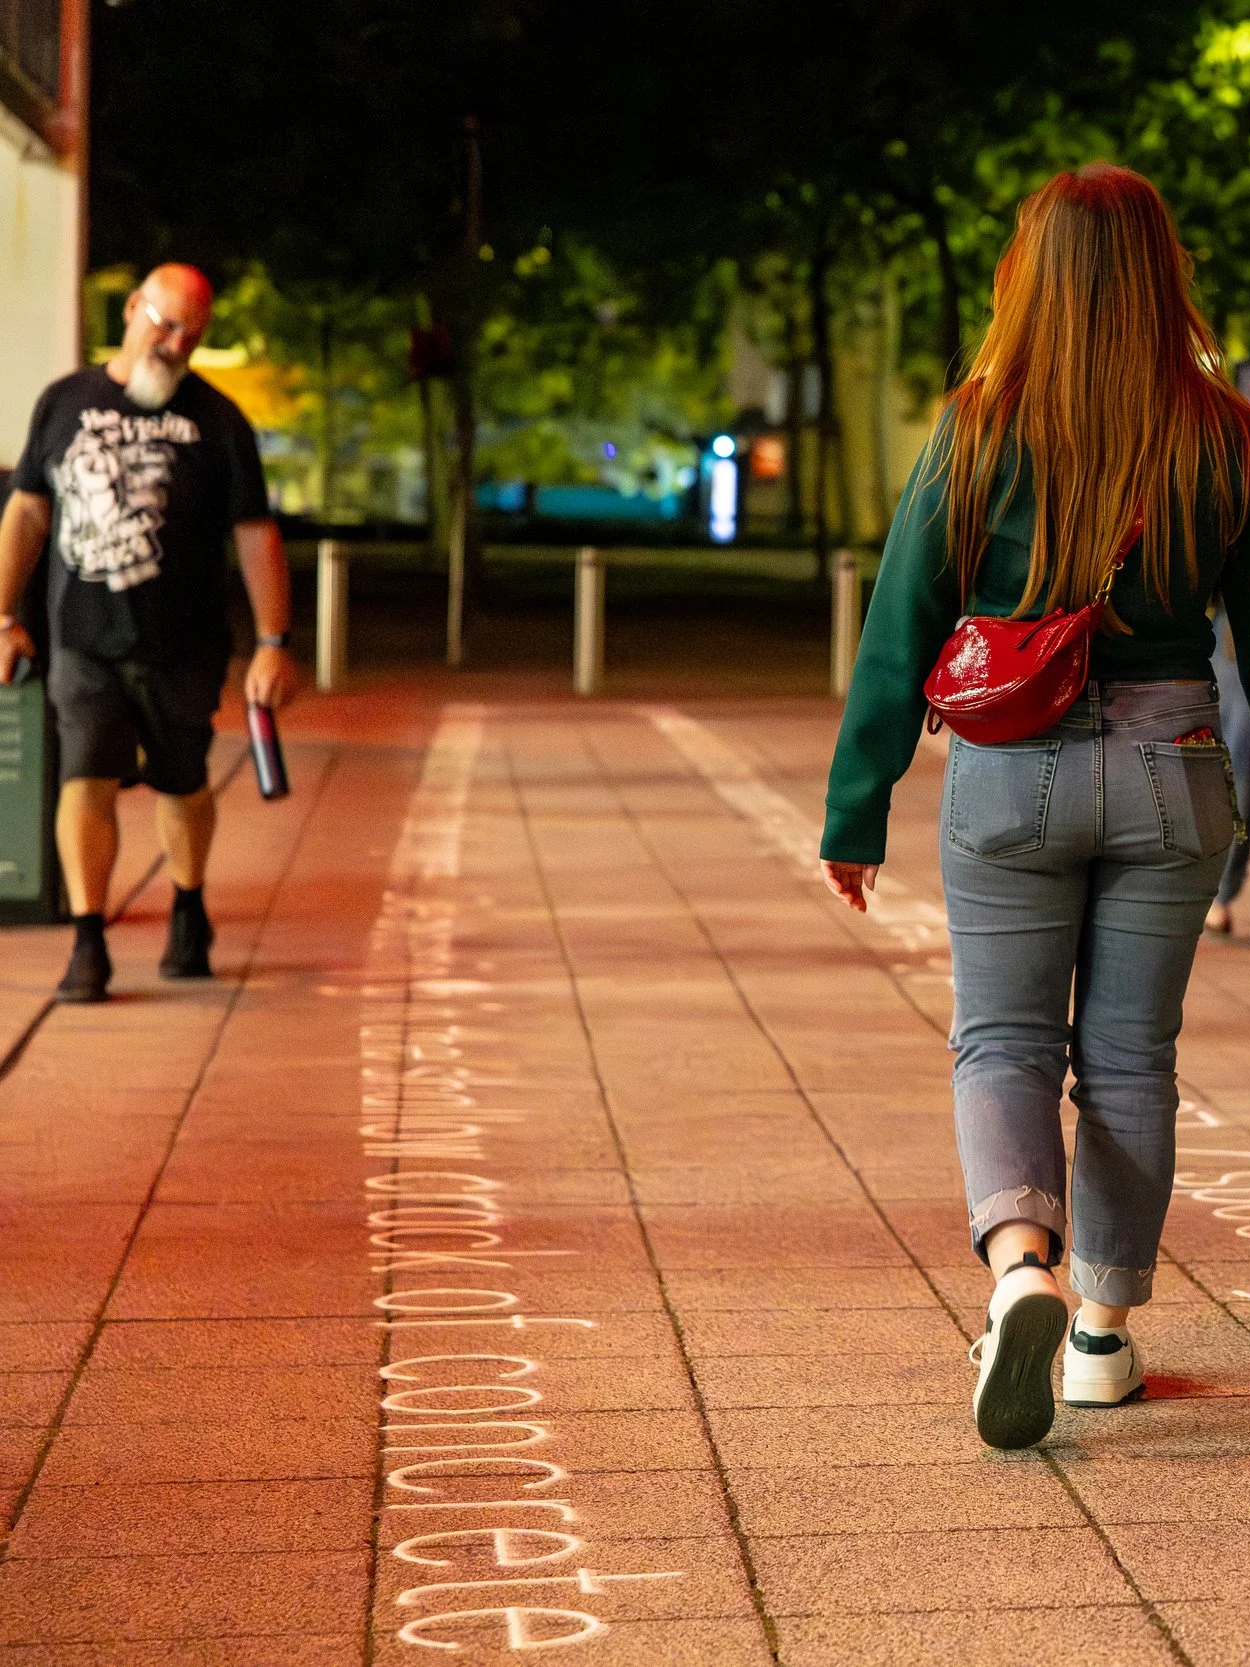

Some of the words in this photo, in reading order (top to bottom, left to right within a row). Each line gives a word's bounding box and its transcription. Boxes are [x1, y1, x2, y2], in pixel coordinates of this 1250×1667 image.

[364, 1170, 580, 1272] crack
[374, 1288, 595, 1329] of
[379, 1353, 688, 1651] concrete
